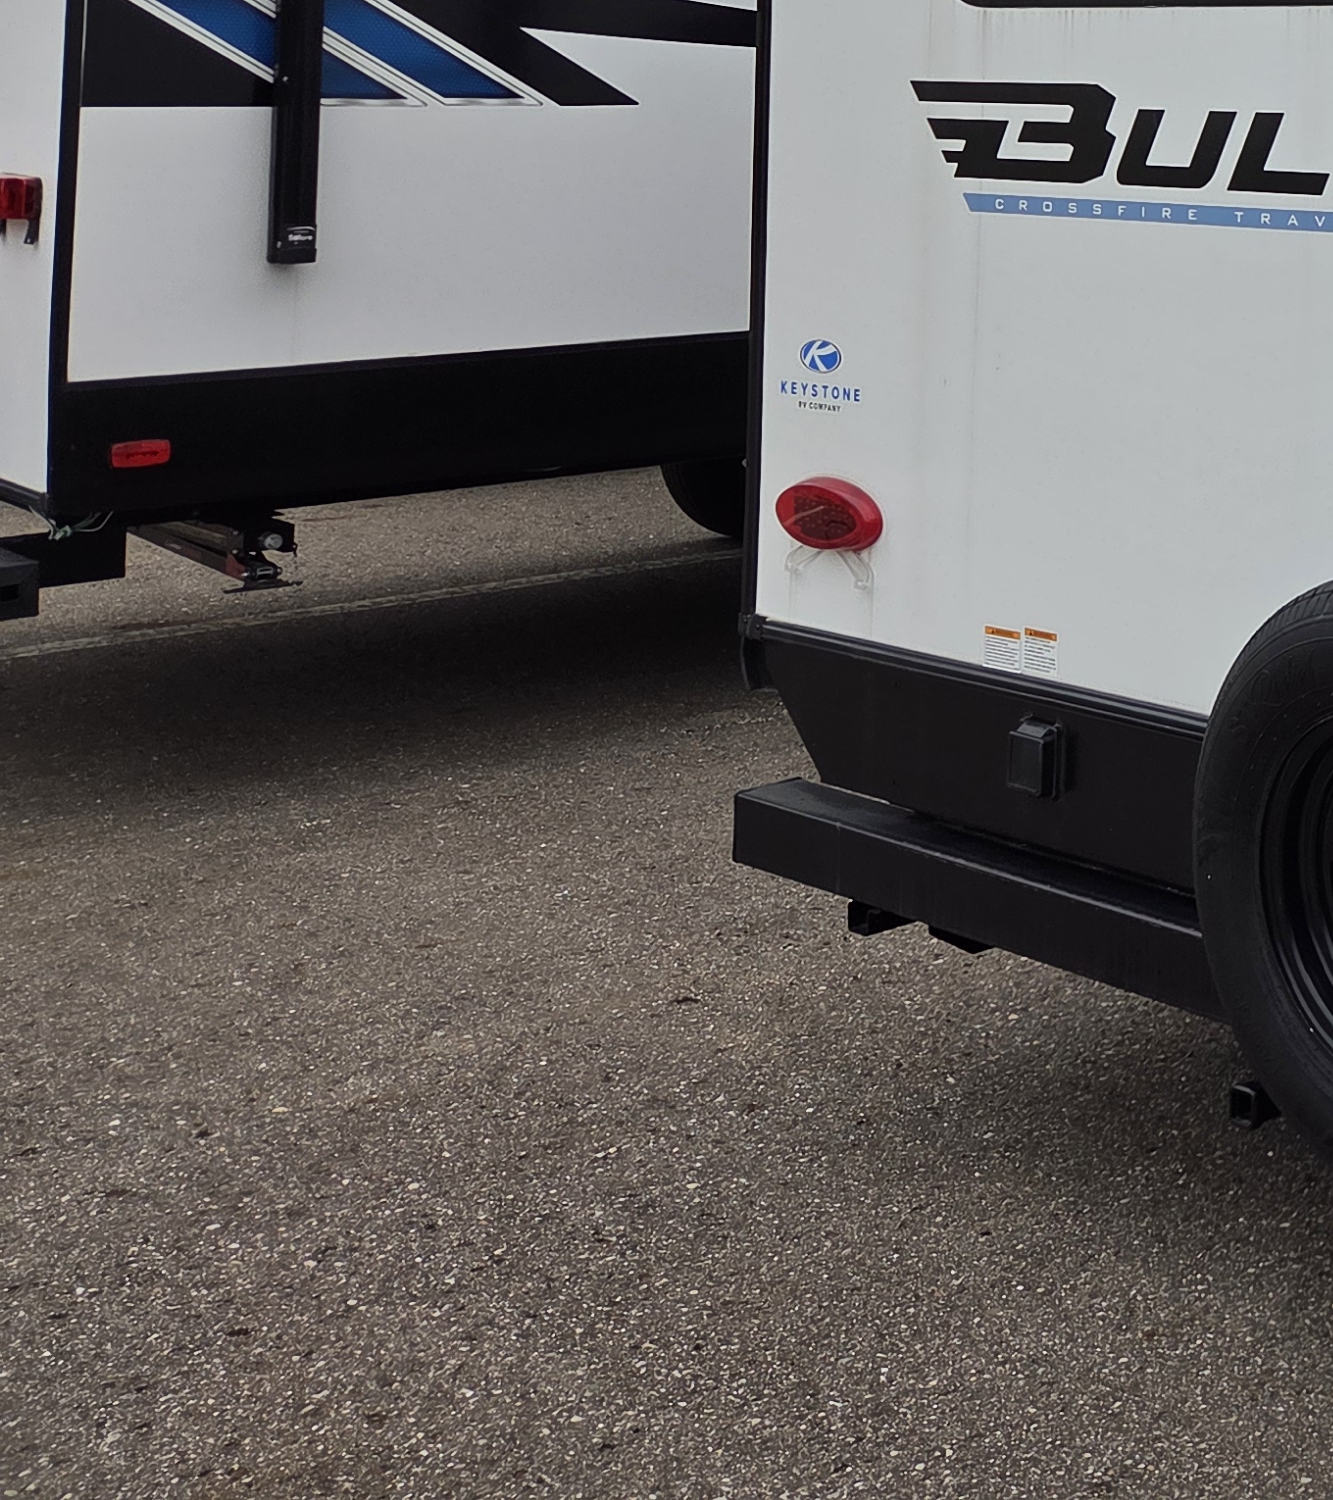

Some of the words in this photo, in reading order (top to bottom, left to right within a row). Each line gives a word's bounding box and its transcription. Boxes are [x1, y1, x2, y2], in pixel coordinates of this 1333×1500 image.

[994, 197, 1198, 222] CROSSFIRE
[780, 380, 861, 402] KEYSTONE
[809, 401, 841, 413] COMPANY
